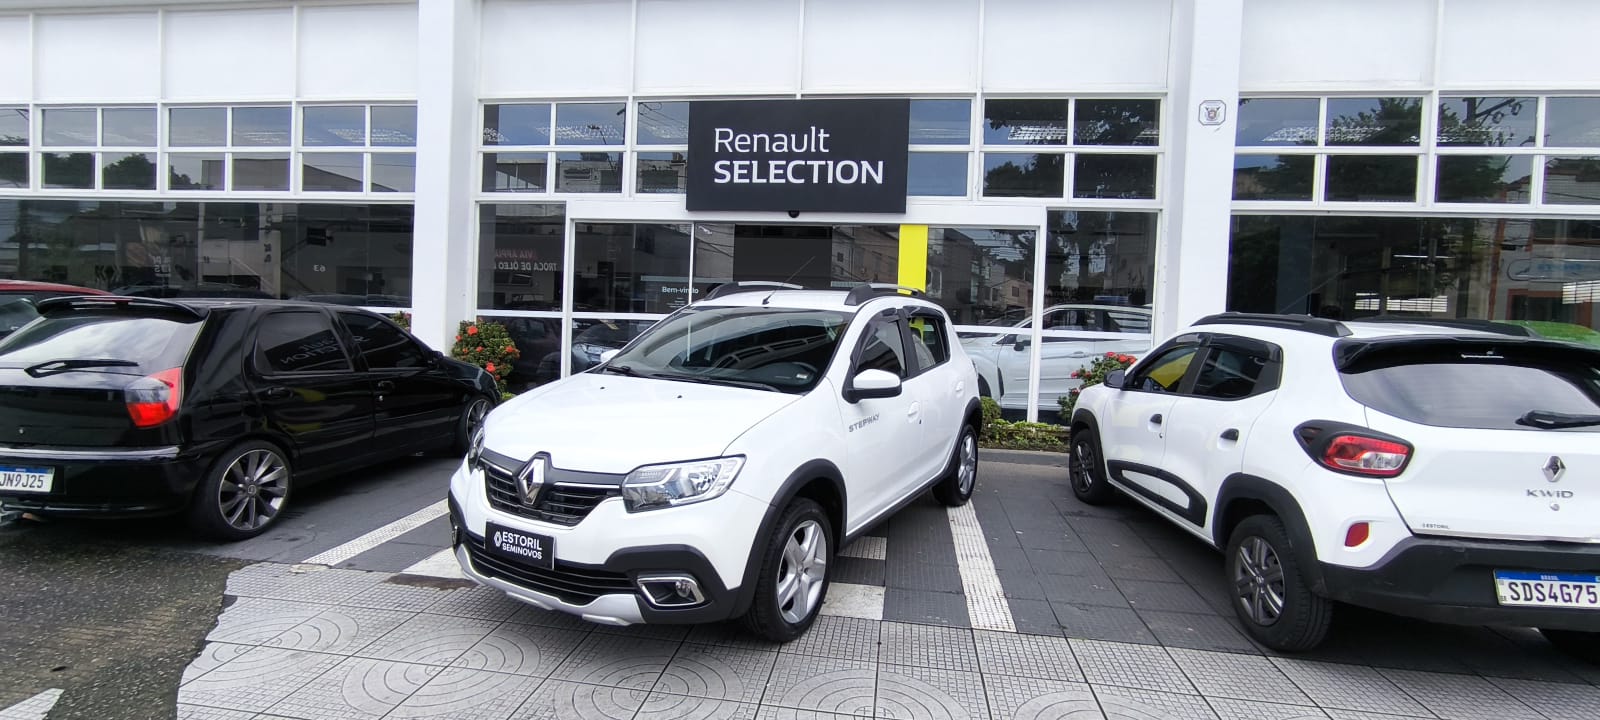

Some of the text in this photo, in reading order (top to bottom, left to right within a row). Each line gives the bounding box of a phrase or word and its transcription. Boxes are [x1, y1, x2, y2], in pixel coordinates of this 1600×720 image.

[714, 126, 830, 152] Renault
[714, 160, 884, 184] SELECTION
[848, 412, 880, 433] STEPWAY
[502, 531, 543, 551] ESTORIL
[502, 542, 543, 560] SEMINOVOS
[1508, 582, 1598, 604] SDS4G75
